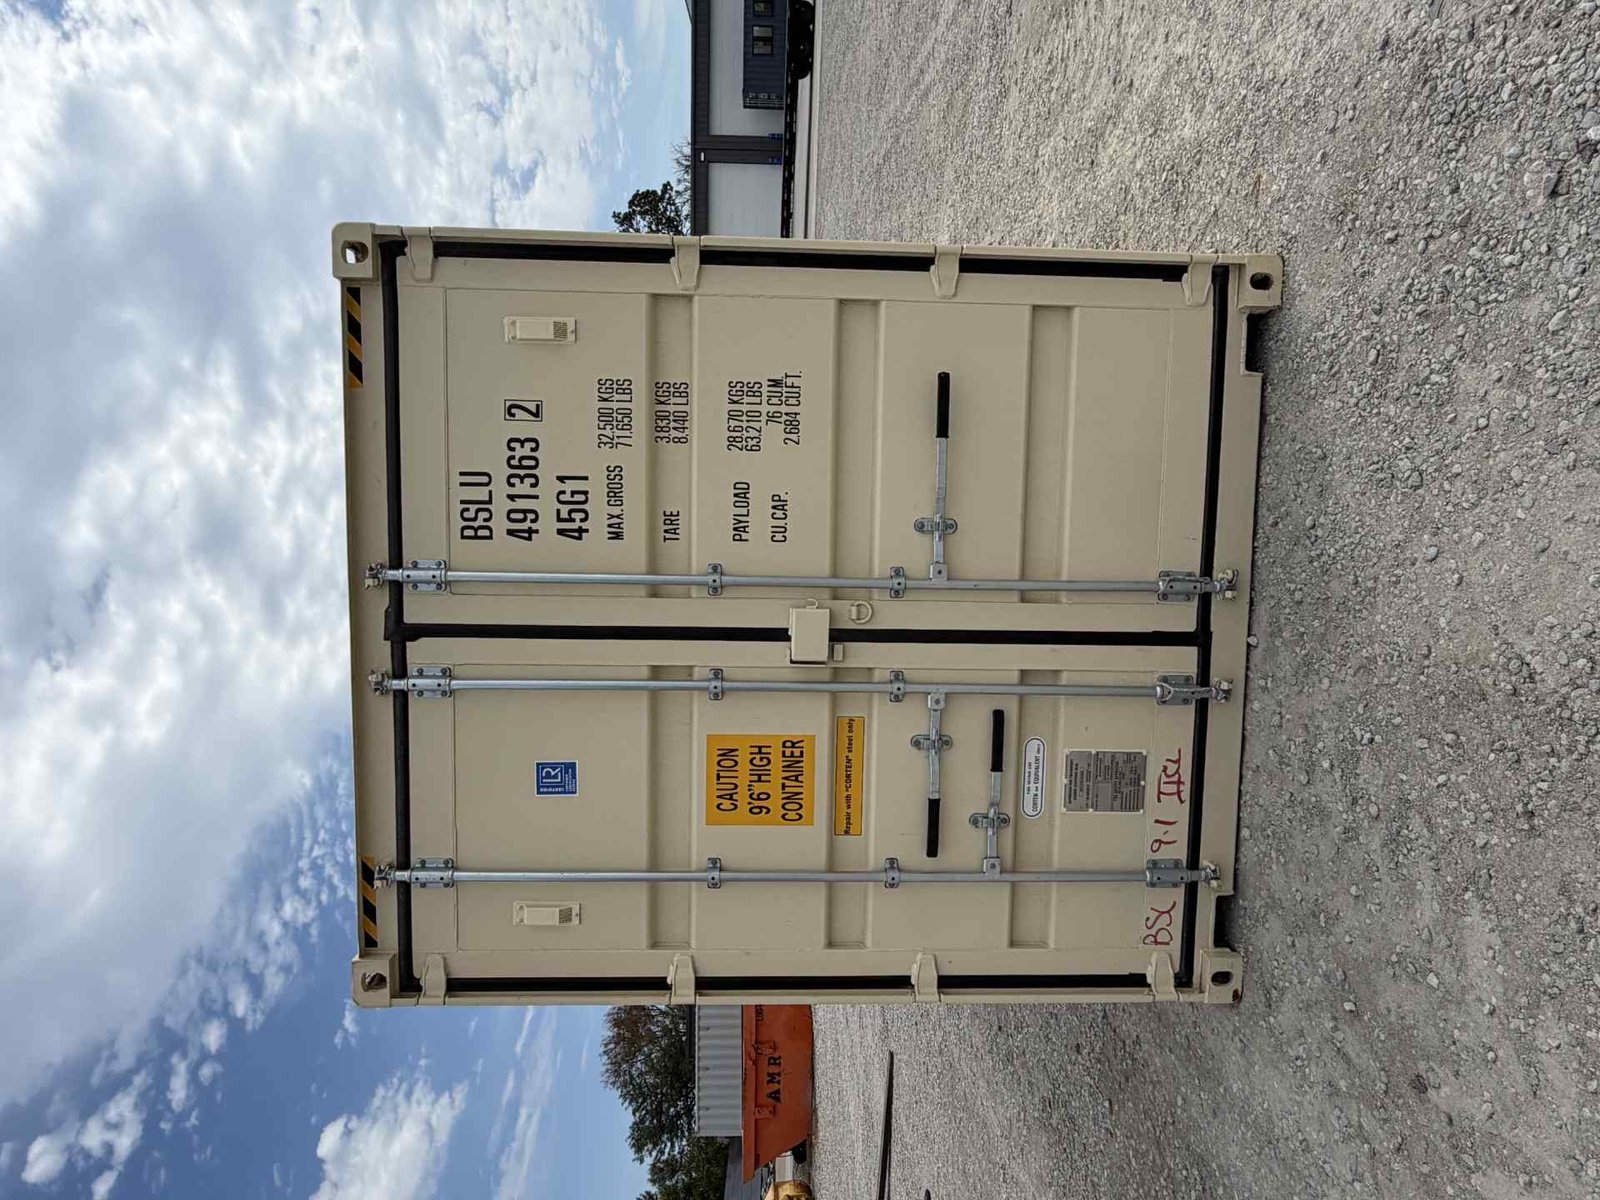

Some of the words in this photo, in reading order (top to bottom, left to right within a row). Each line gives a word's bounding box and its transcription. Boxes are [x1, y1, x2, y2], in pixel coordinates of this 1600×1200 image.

[598, 378, 615, 403] KGS
[616, 379, 632, 403] LBS
[655, 382, 671, 405] KGS
[672, 382, 689, 405] LBS
[728, 381, 744, 405] KGS
[746, 382, 762, 405] LBS
[507, 403, 541, 419] 2
[616, 408, 633, 448] 71,650
[655, 409, 672, 444] 3,830
[673, 410, 689, 444] 8,440
[767, 411, 783, 426] 76
[785, 411, 802, 445] 2,684
[598, 408, 615, 449] 32,500
[728, 409, 745, 451] 28,670
[746, 410, 762, 452] 63,210
[459, 471, 493, 540] BSLU
[506, 437, 540, 541] 491363
[556, 475, 589, 541] 45G1
[733, 482, 750, 542] PAYLOAD
[663, 510, 680, 542] TARE
[846, 718, 855, 733] only
[716, 748, 740, 812] CAUTION
[781, 739, 805, 822] CONTAINER
[844, 794, 852, 809] with
[843, 812, 852, 834] Repair
[766, 1056, 781, 1103] AMR
